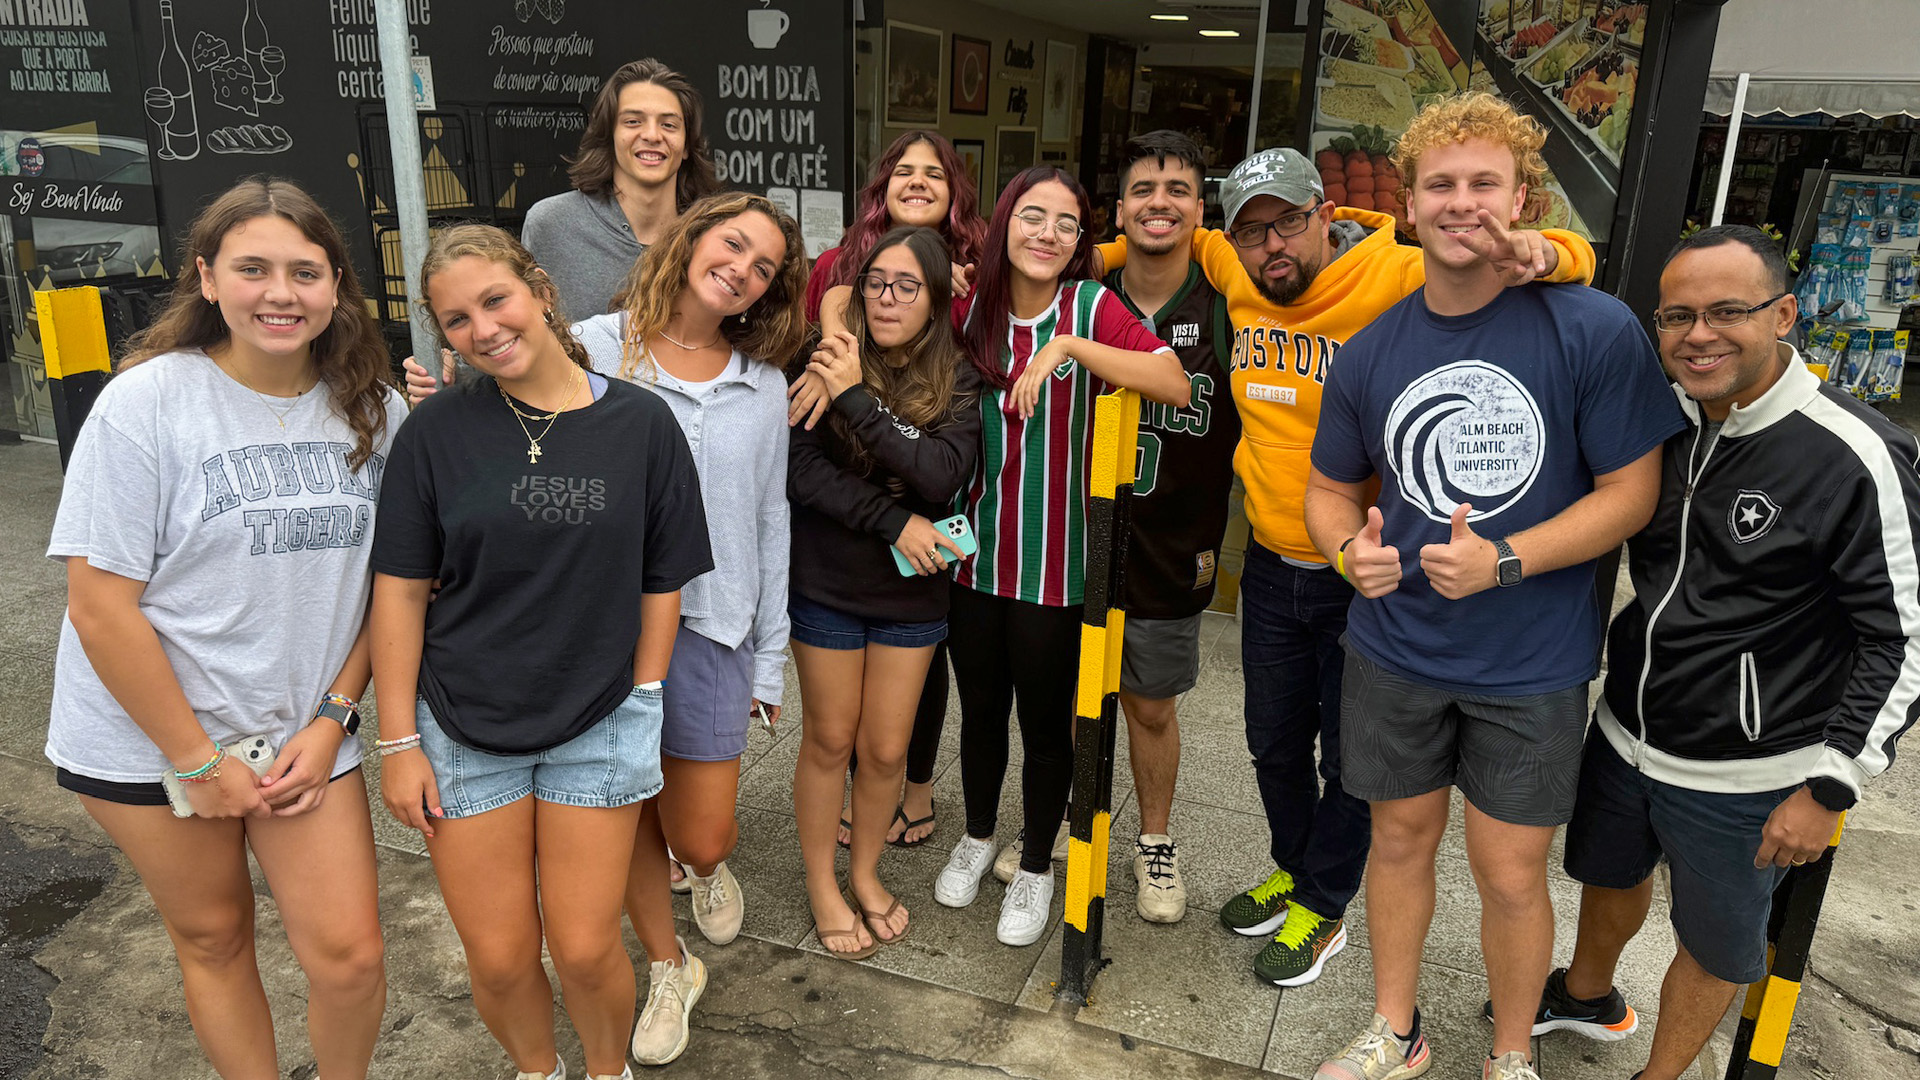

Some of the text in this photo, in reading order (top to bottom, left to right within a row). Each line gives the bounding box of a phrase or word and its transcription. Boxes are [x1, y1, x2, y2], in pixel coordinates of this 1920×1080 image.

[0, 0, 89, 26] NTRADA
[332, 28, 378, 67] líqui
[488, 25, 594, 66] Pessoas que gostam
[22, 47, 91, 70] QUE A PORTA
[10, 69, 112, 93] AO LADO SE ABRIRÁ
[493, 65, 600, 103] de comer são sempre
[718, 64, 821, 102] BOM DIA
[725, 107, 815, 145] COM UM
[714, 144, 828, 188] BOM CAFÉ
[1234, 153, 1286, 179] SICILIA
[1242, 173, 1275, 191] ITALIA
[1172, 323, 1200, 338] VISTA
[1172, 336, 1199, 347] PRINT
[1248, 385, 1294, 402] EST 1997
[1487, 422, 1524, 435] BEACH
[1454, 458, 1519, 472] UNIVERSITY
[511, 475, 606, 494] JESUS
[510, 489, 606, 511] LOVES
[521, 505, 592, 526] YOU.
[243, 505, 369, 555] TIGERS
